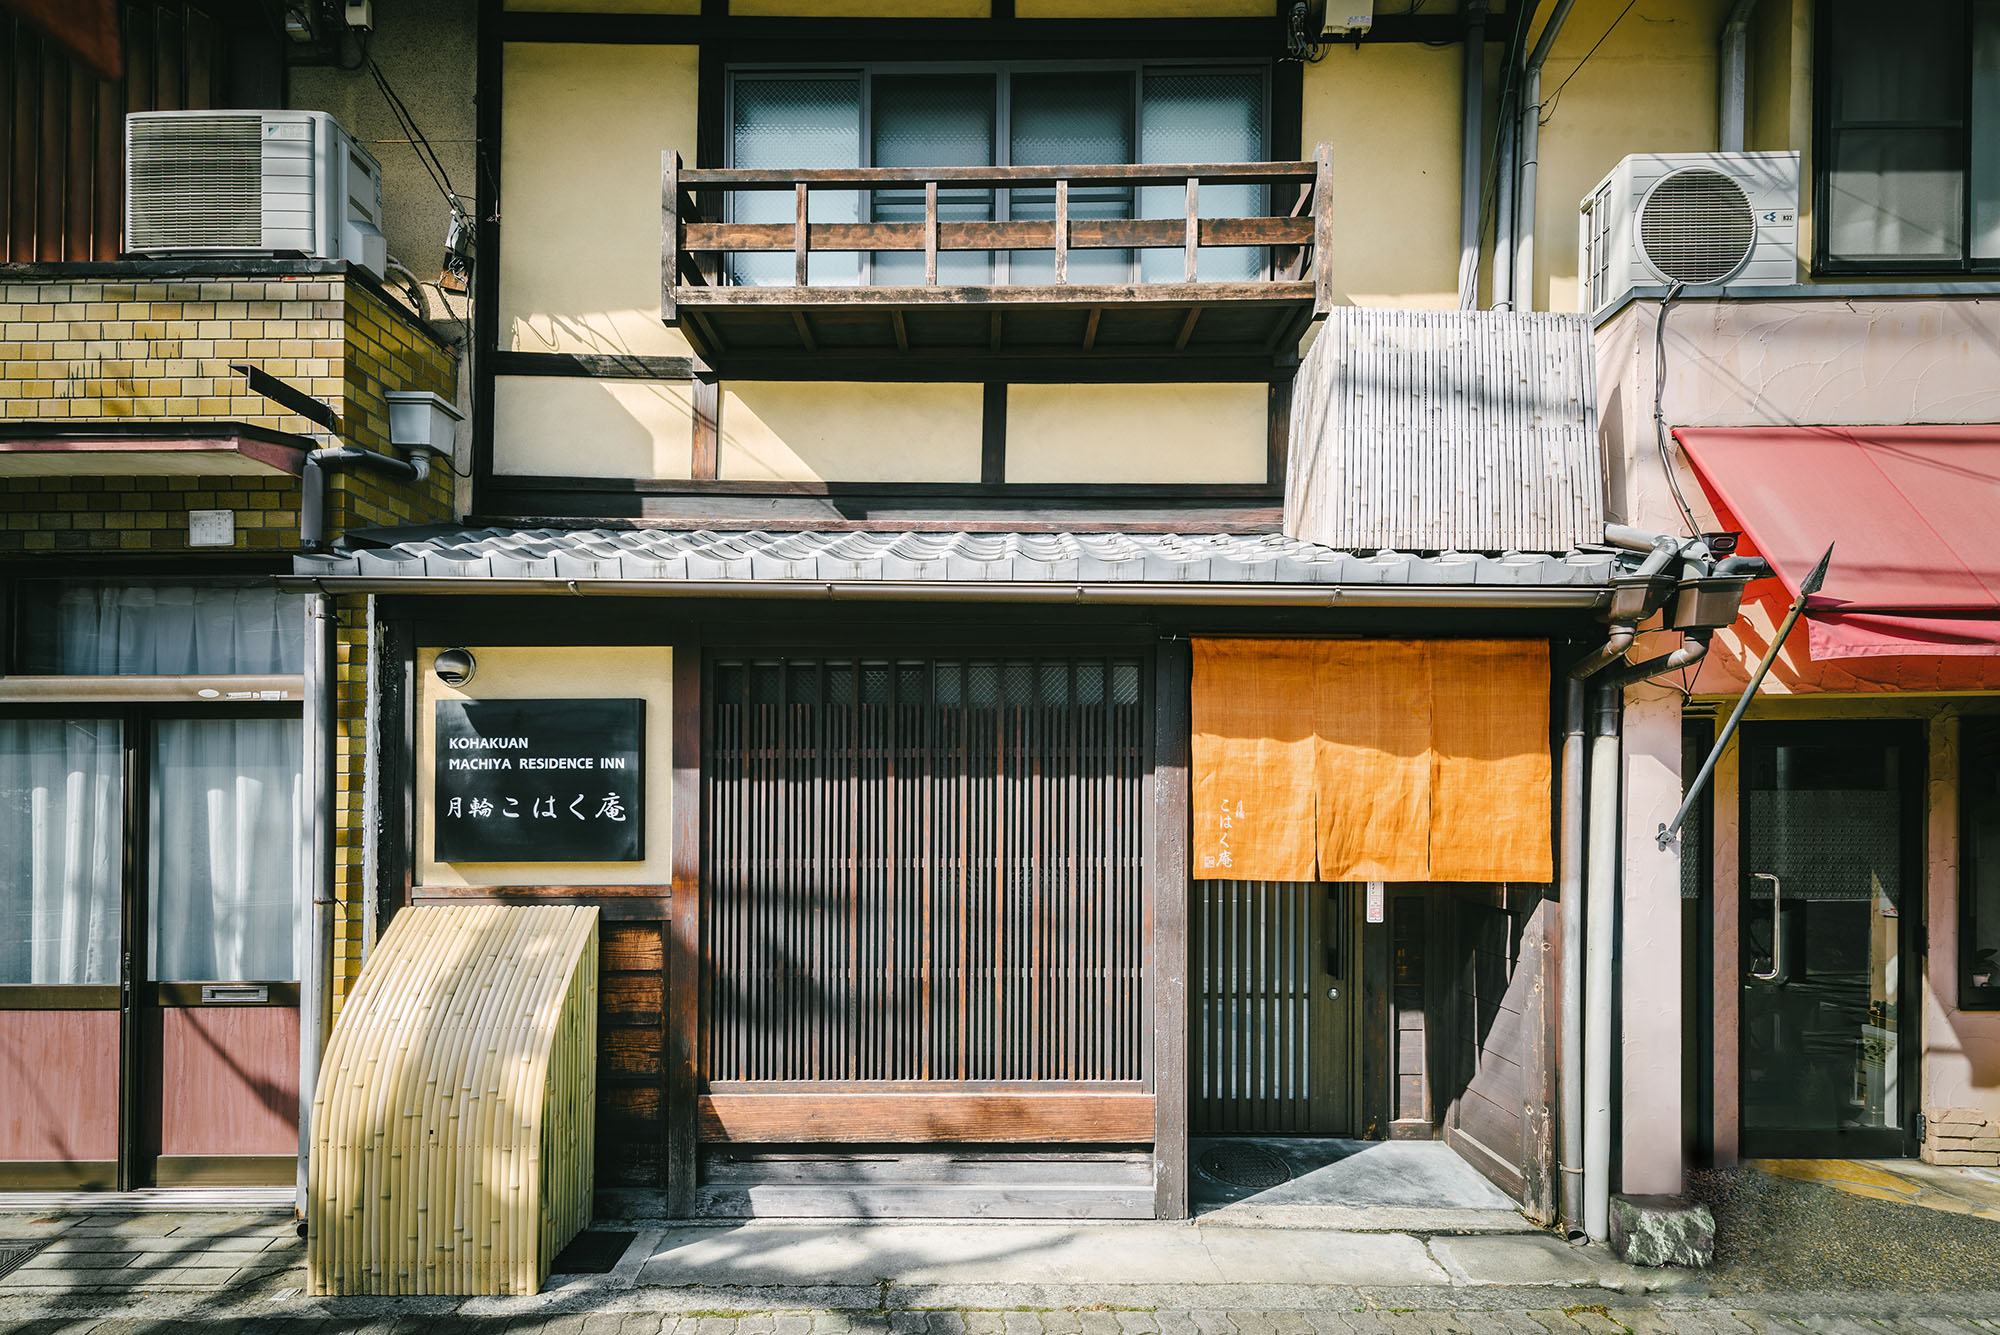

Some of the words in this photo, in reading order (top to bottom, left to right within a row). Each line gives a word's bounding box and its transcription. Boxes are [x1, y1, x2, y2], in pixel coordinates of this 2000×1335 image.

[449, 737, 529, 750] KOHAKUAN
[449, 757, 512, 770] MACHIYA
[519, 757, 594, 769] RESIDENCE
[600, 757, 625, 769] INN
